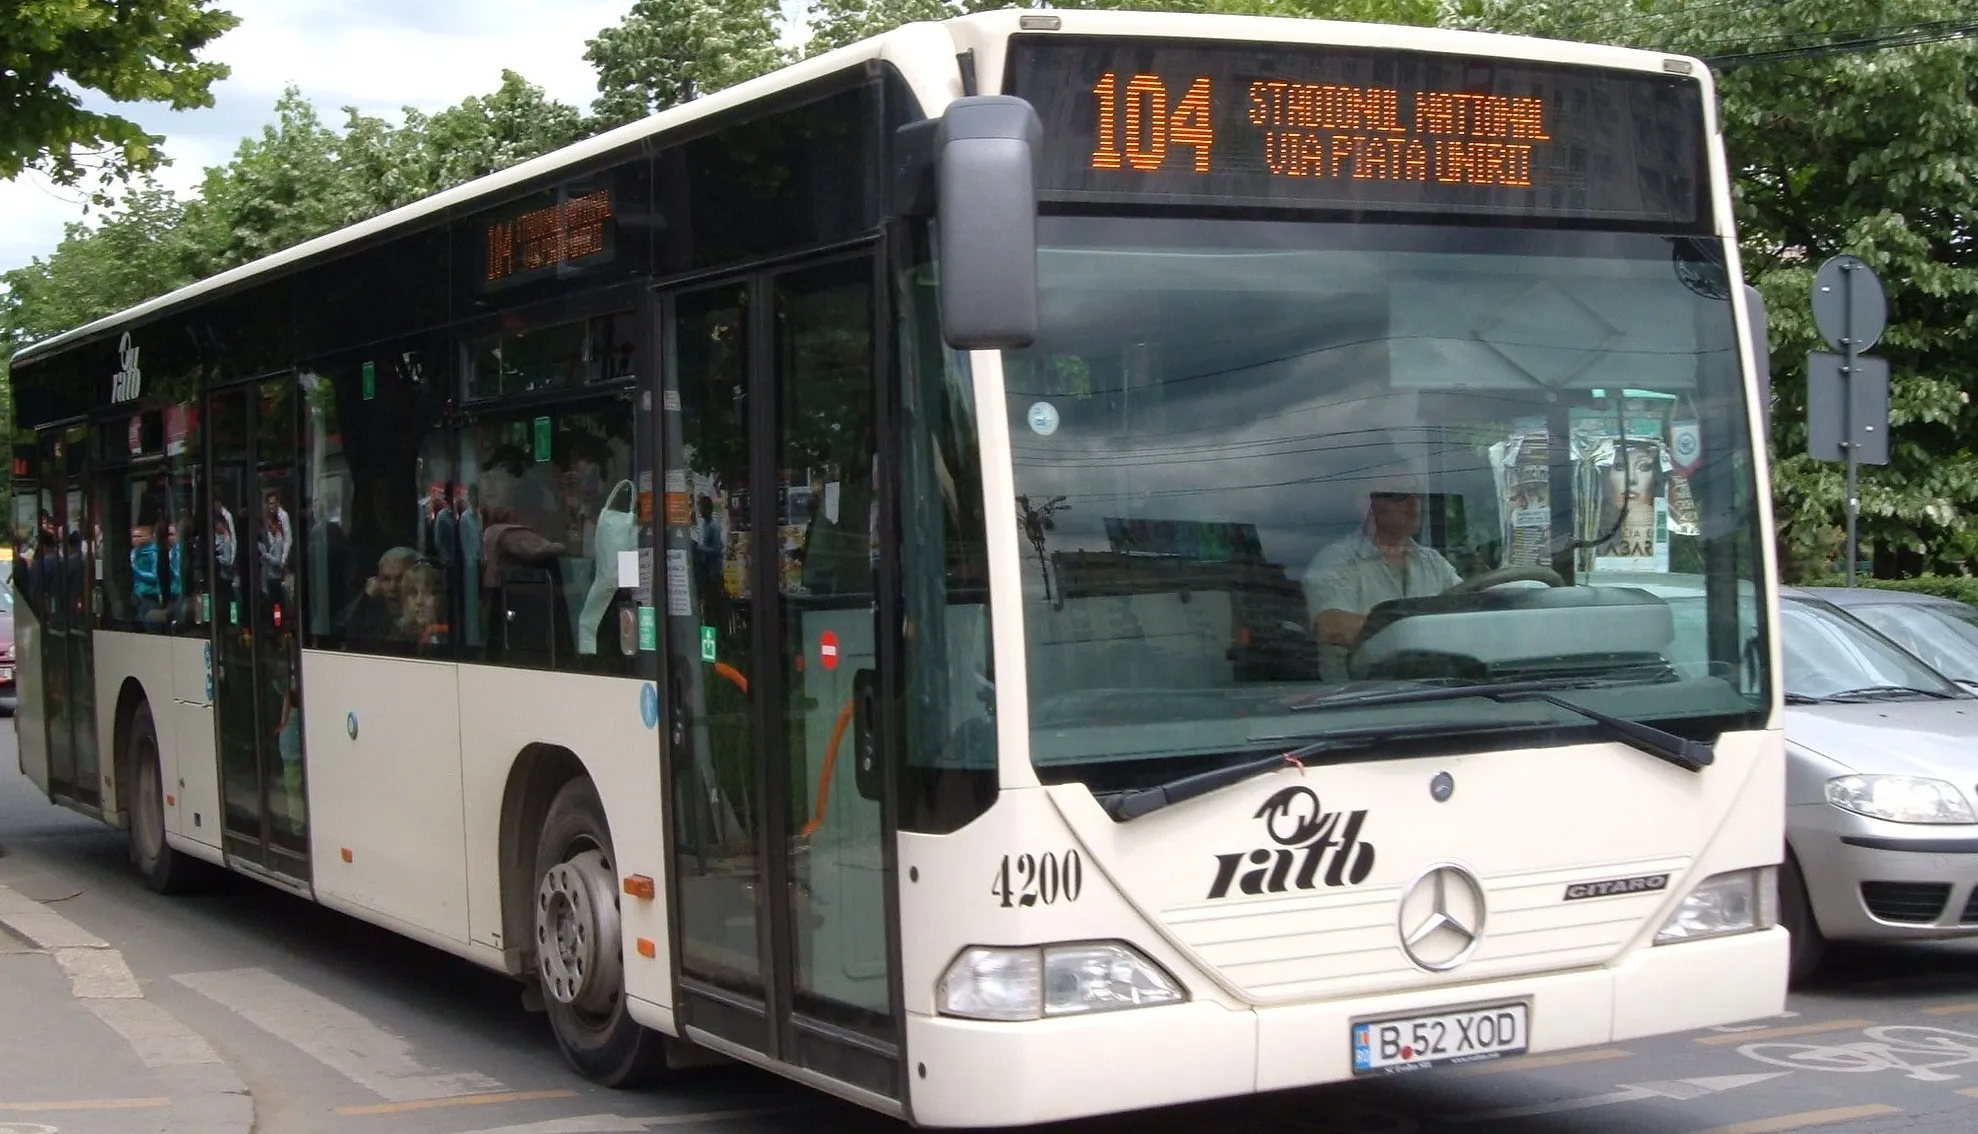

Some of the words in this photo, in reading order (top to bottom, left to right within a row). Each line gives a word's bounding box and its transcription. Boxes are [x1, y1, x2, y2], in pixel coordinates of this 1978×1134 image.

[1091, 73, 1213, 172] 104
[1249, 81, 1407, 133] STADIONUL
[1416, 91, 1550, 140] NATIONAL
[1266, 131, 1322, 177] VIA
[1332, 134, 1426, 181] PIATA
[1435, 140, 1532, 186] UNIRII
[991, 848, 1083, 908] 4200
[1206, 809, 1376, 900] ratb
[1567, 876, 1667, 898] CITARO
[1413, 1020, 1447, 1056] 52
[1456, 1012, 1515, 1051] XOD
